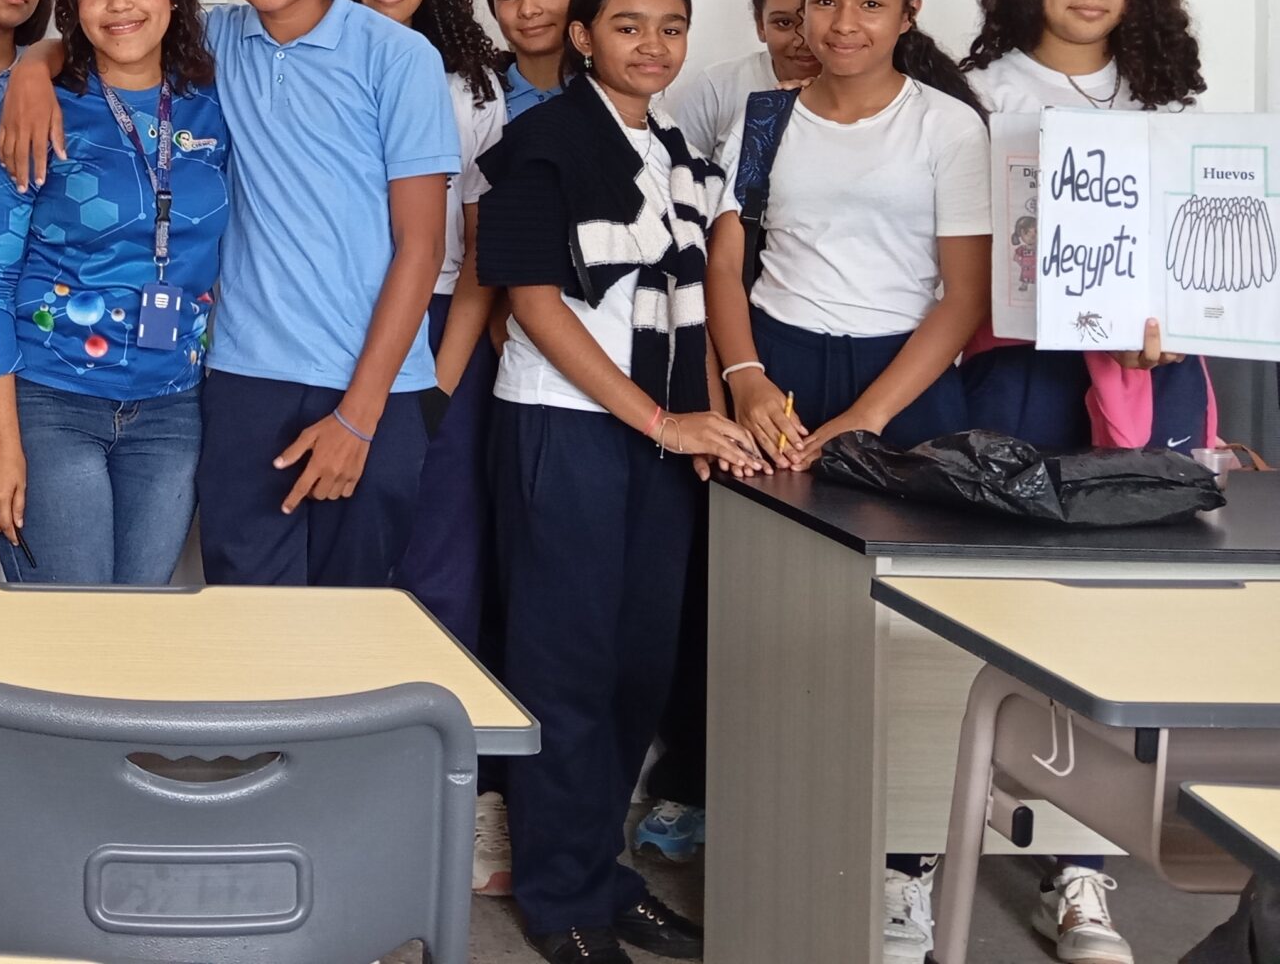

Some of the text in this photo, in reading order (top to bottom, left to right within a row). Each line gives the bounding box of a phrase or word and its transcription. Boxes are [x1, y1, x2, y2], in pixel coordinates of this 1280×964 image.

[1051, 146, 1139, 209] Aedes
[1203, 167, 1256, 181] Huevos
[1042, 224, 1137, 297] Aegypti
